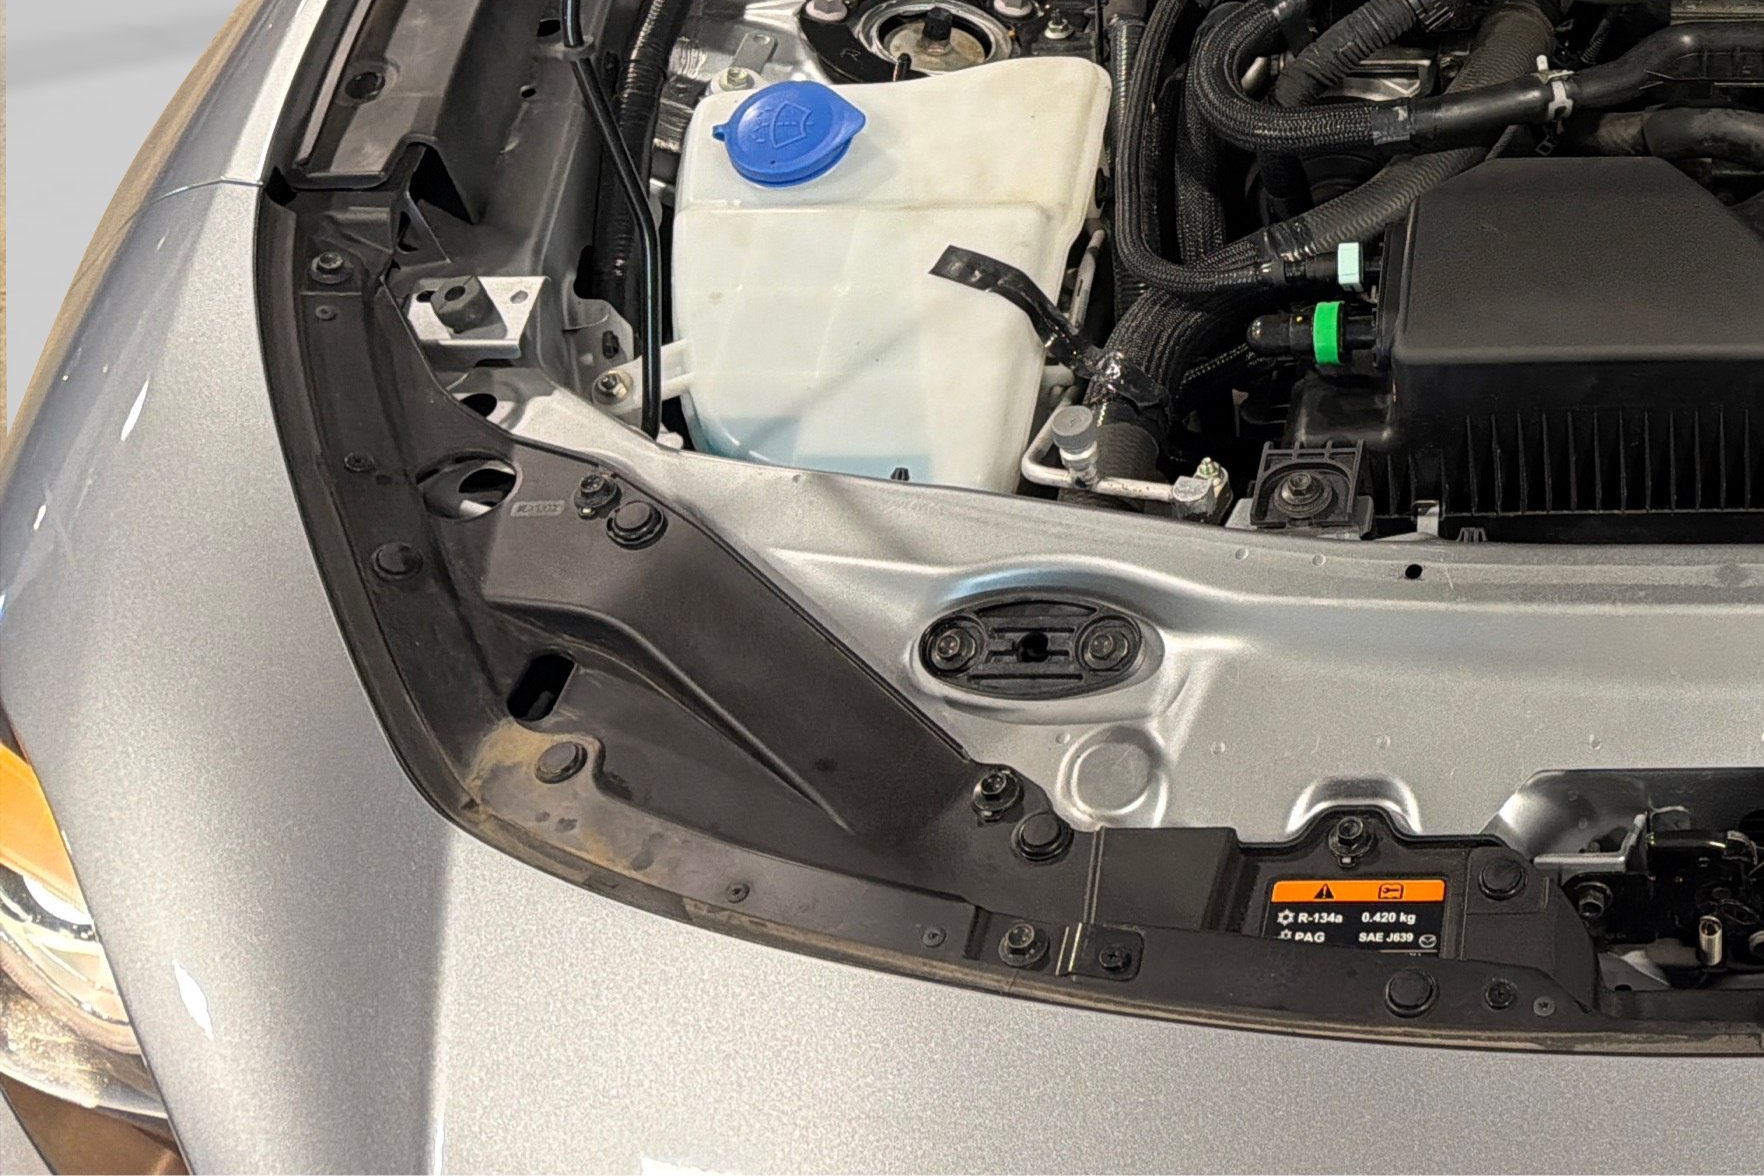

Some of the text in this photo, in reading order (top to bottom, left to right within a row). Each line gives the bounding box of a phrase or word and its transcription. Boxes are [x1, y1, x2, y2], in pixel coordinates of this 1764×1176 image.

[1297, 911, 1416, 926] R-134a 0.420 kg
[1295, 931, 1414, 943] PAG SAE J639
